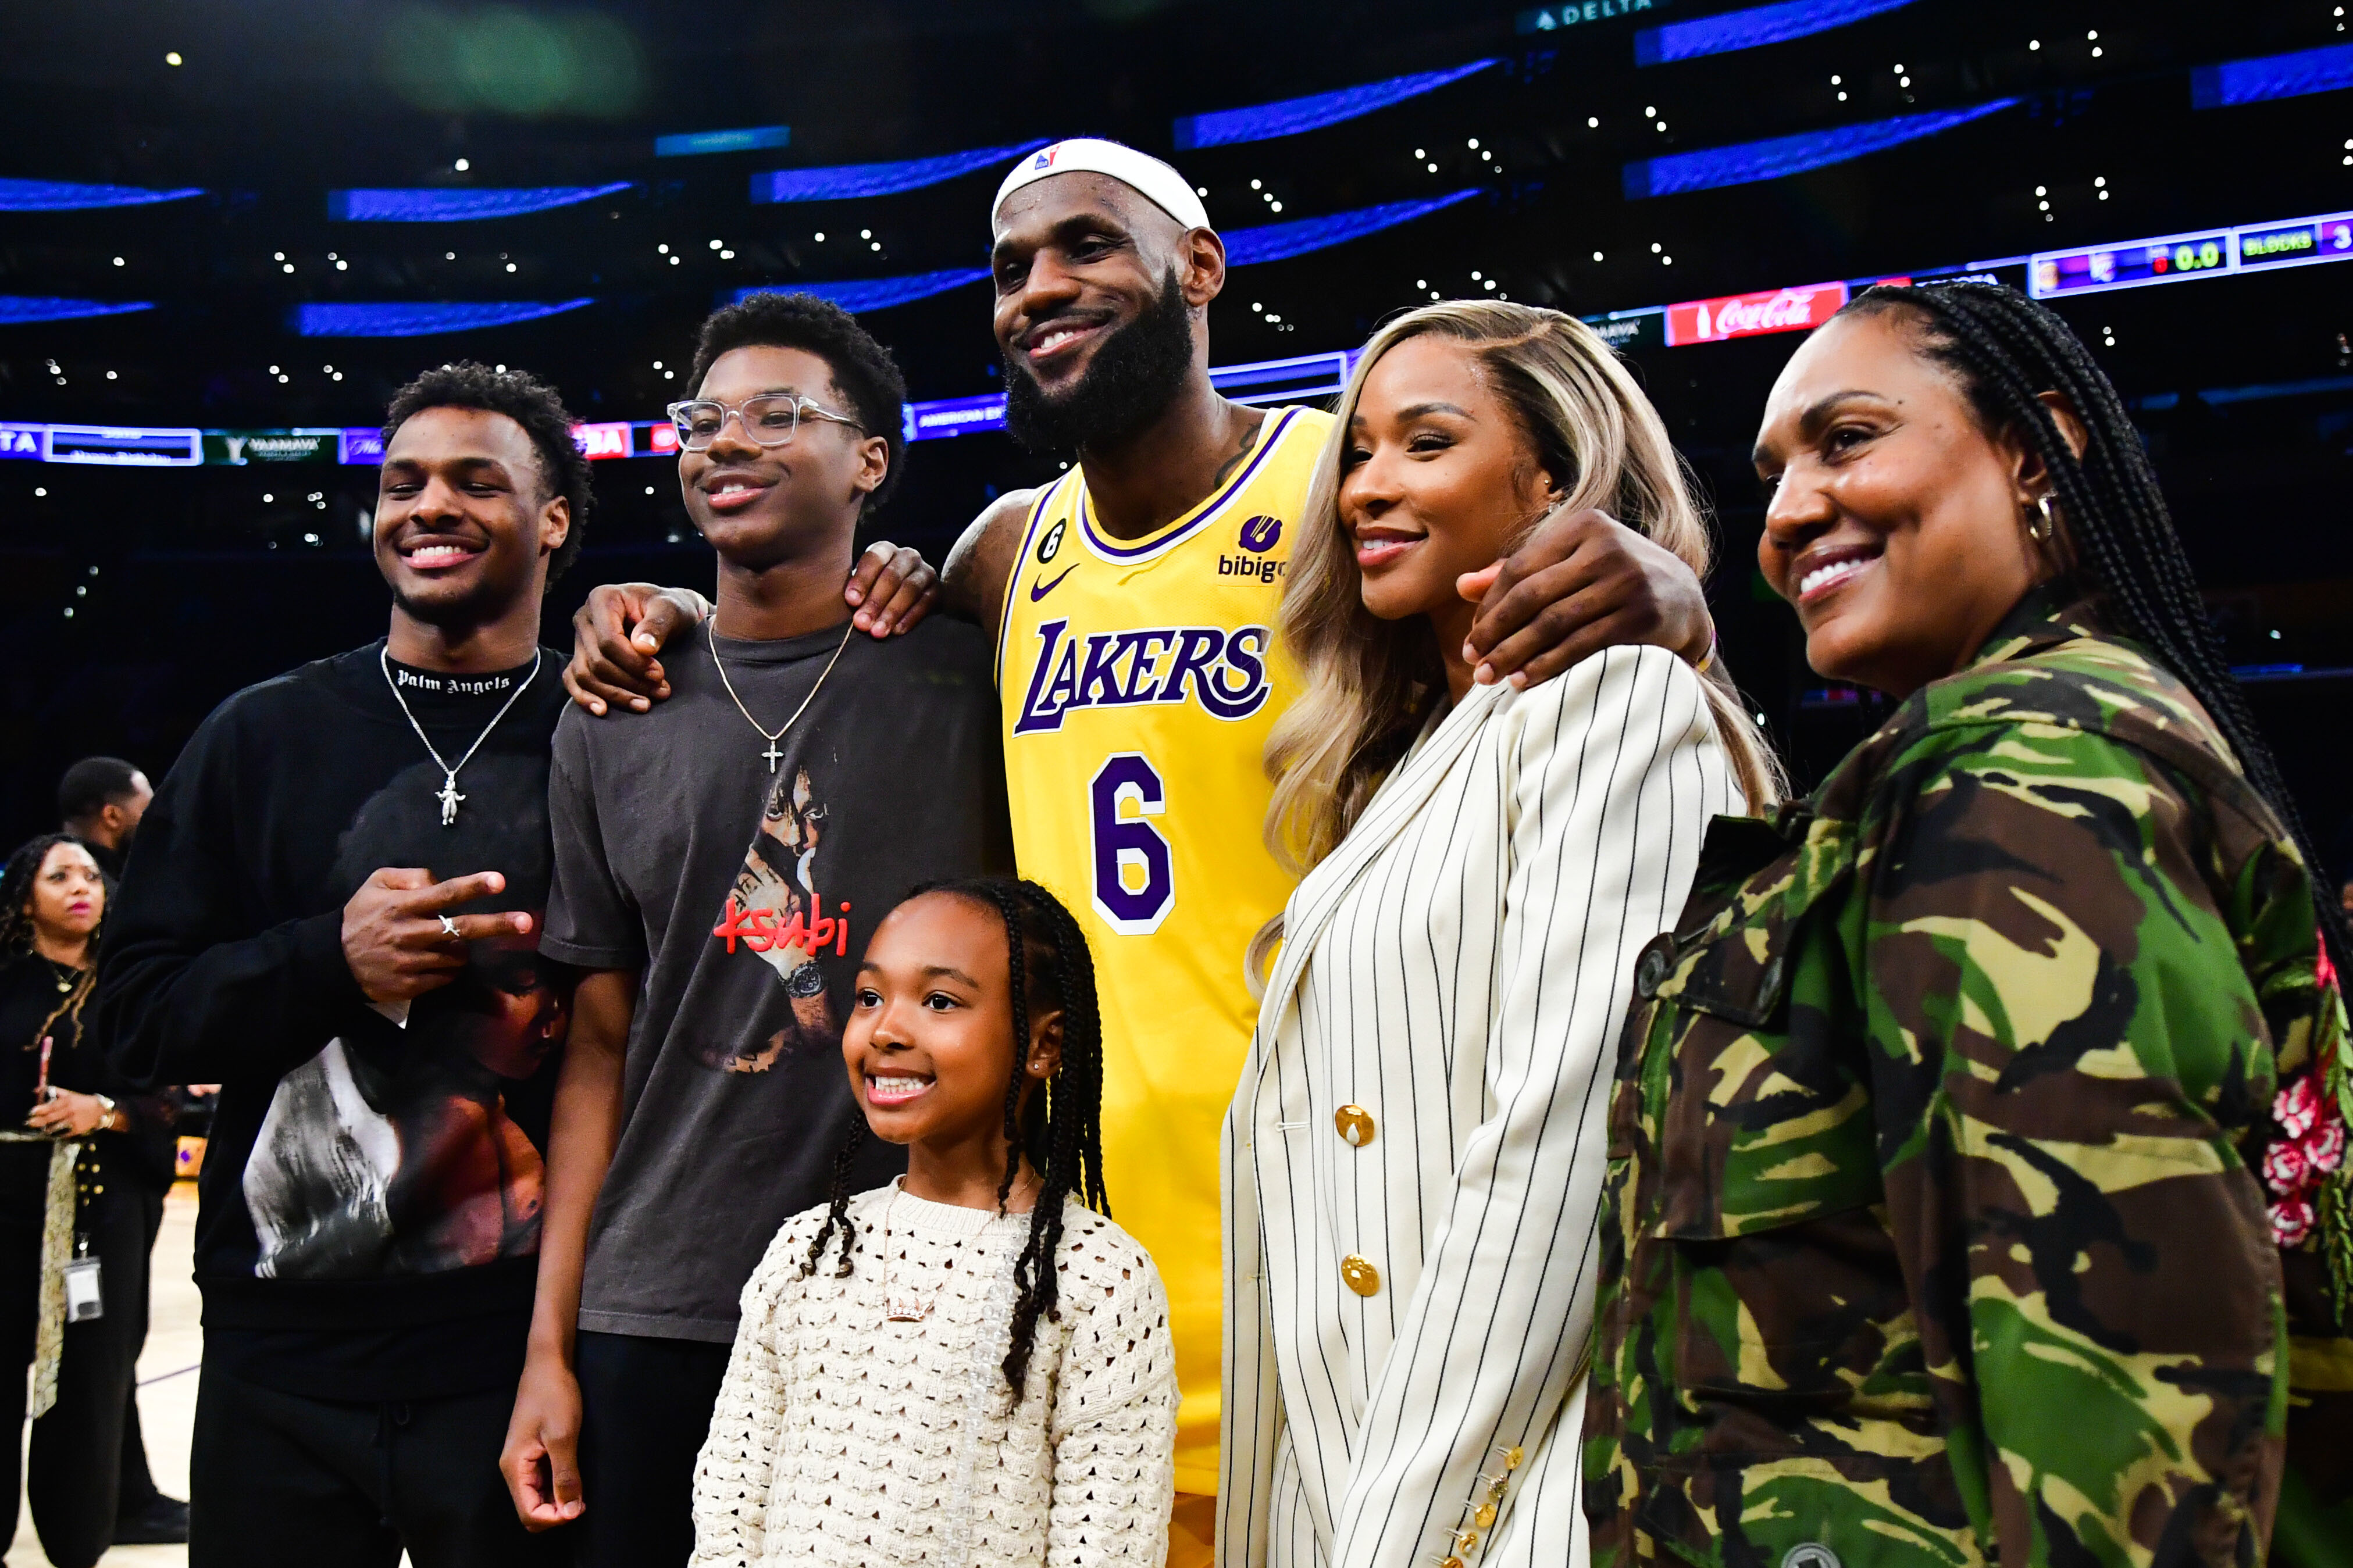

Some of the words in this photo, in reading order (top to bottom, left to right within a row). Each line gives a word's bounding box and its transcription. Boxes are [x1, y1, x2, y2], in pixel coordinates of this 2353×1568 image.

[2175, 243, 2219, 270] 0.0
[2243, 231, 2312, 256] BLOCKS
[2333, 225, 2352, 249] 3
[919, 408, 985, 428] AMERICAN
[1043, 524, 1063, 558] 6
[398, 669, 440, 690] Palm
[447, 677, 509, 695] Angels
[1012, 616, 1274, 738] LAKERS
[1088, 751, 1175, 935] 6
[714, 894, 850, 956] ksubi
